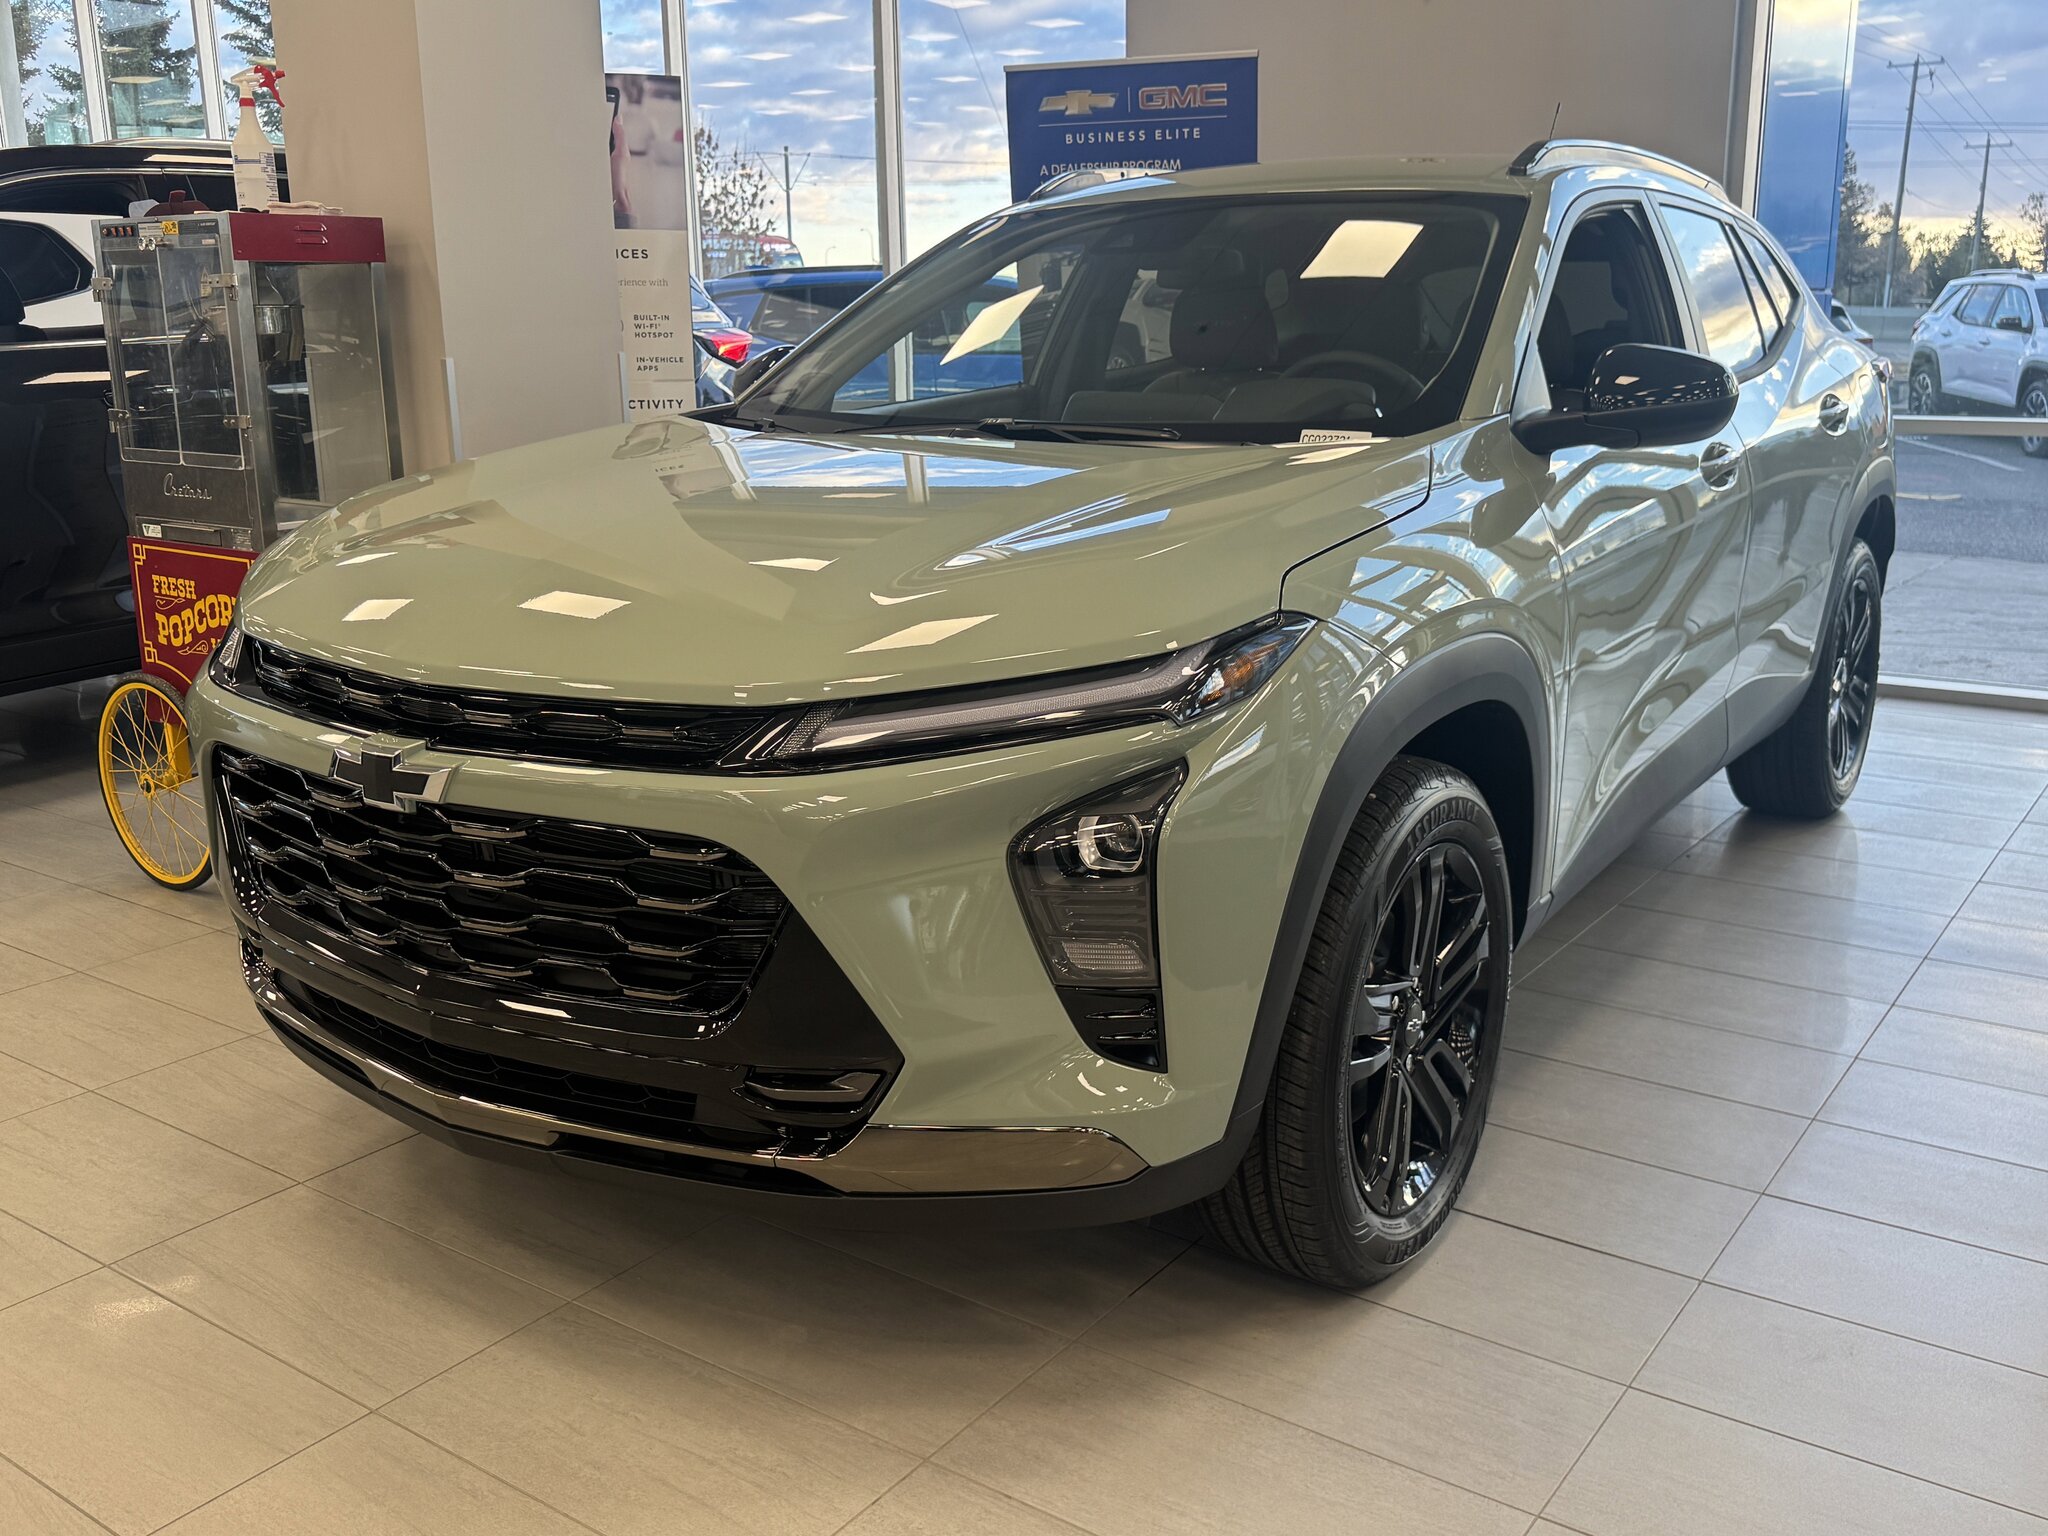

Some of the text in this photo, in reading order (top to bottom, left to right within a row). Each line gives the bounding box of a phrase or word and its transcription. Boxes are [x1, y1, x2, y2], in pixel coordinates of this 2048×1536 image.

[1139, 83, 1227, 109] GMC
[1065, 127, 1201, 144] BUSINESS ELITE
[1040, 165, 1049, 176] A
[1123, 159, 1181, 170] PROGRAM
[649, 278, 669, 287] with
[151, 574, 197, 600] FRESH
[155, 594, 237, 647] POPCOR
